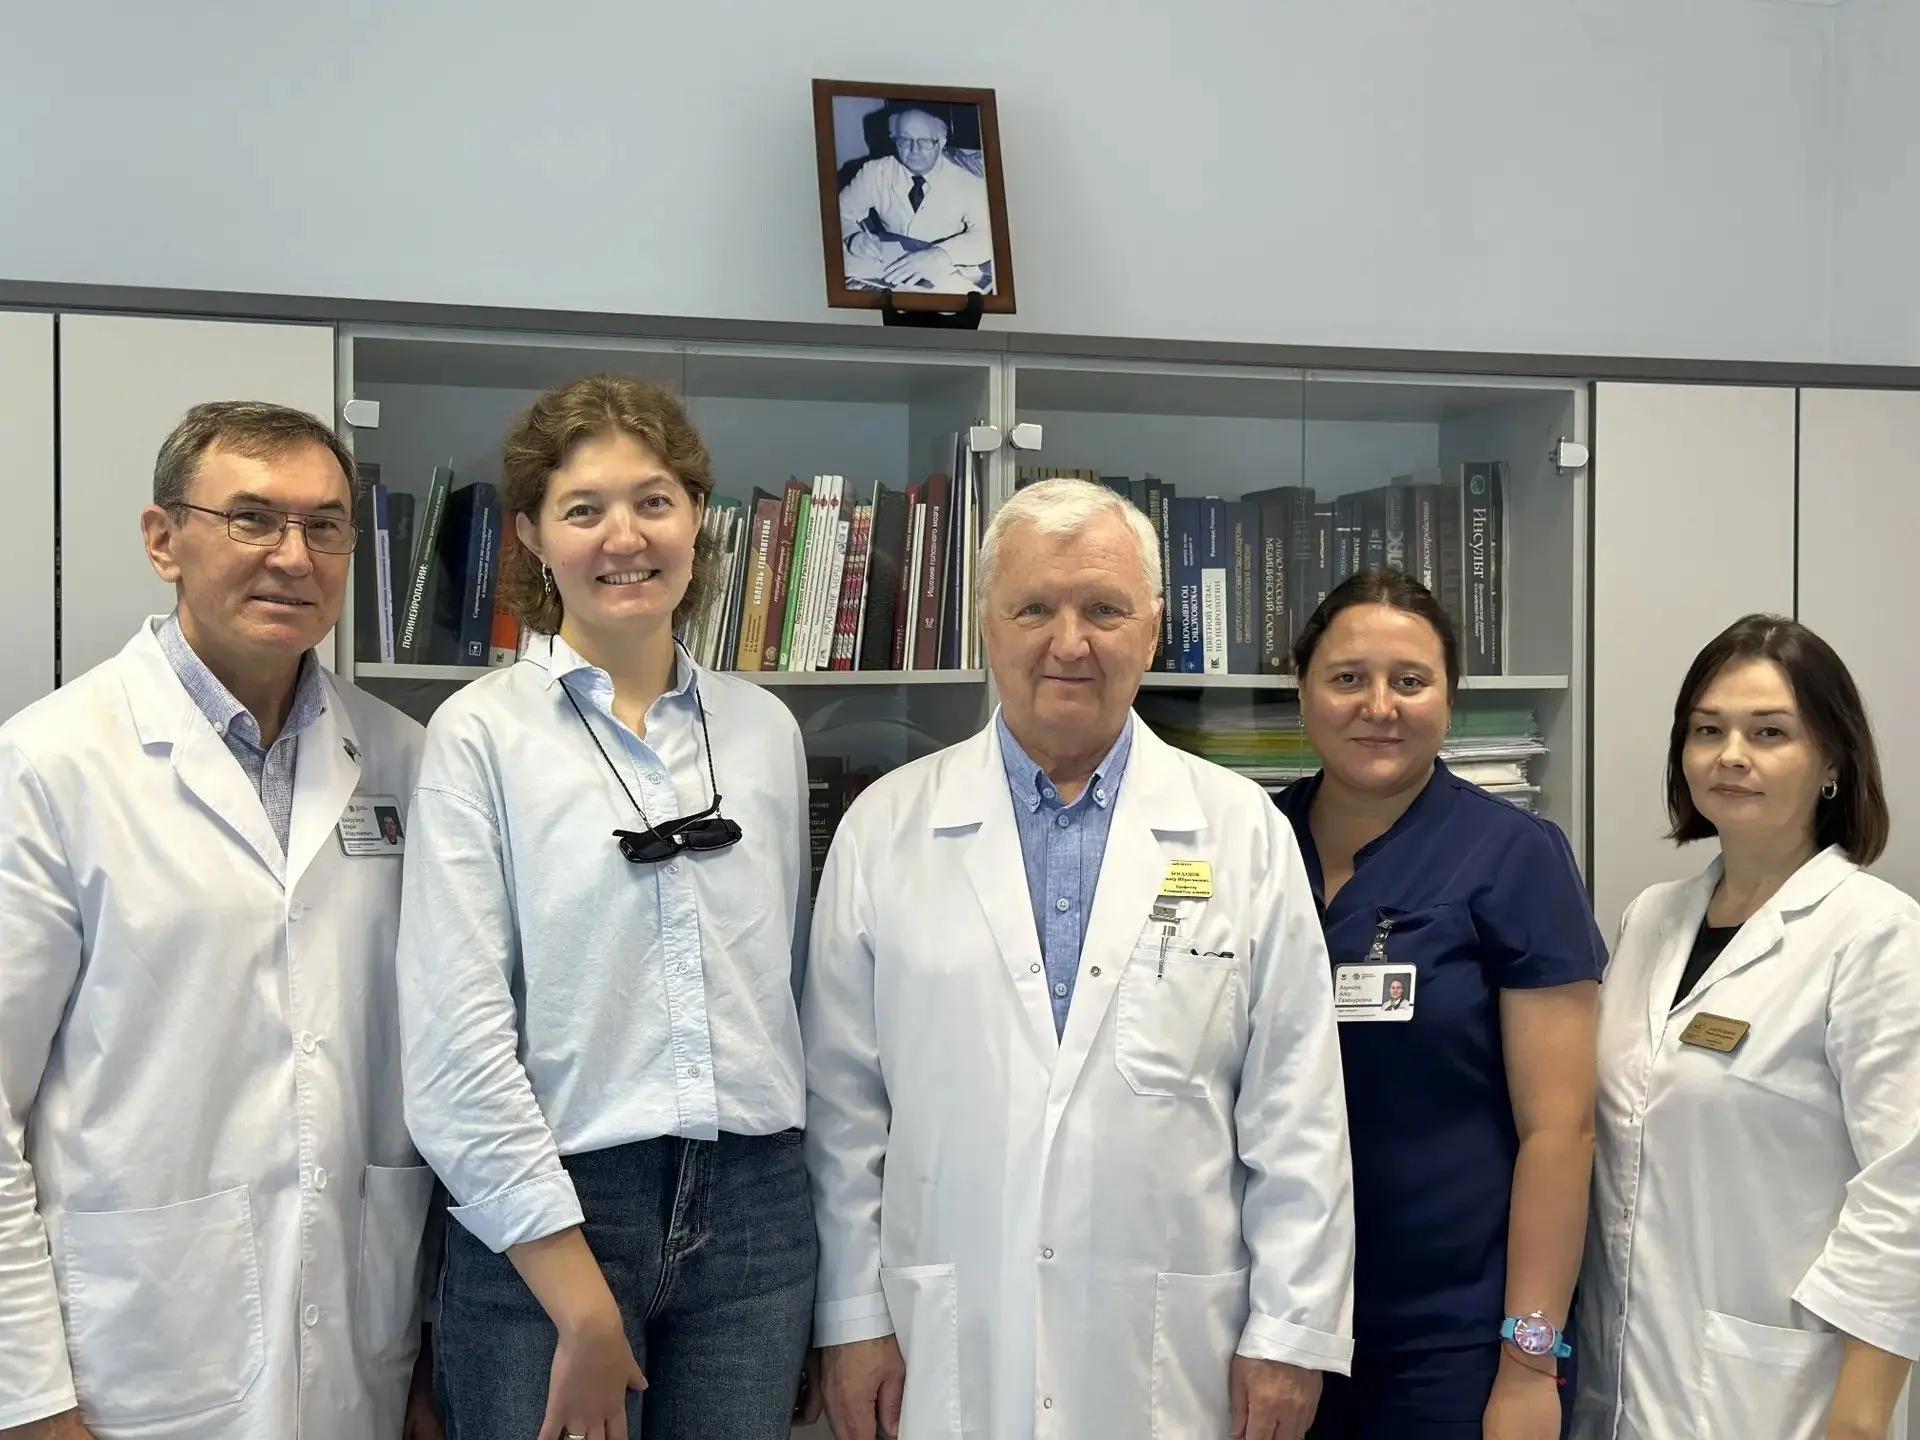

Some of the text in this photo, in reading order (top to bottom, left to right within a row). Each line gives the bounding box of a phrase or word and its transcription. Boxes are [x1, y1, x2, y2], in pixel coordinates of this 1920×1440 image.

[1275, 538, 1284, 616] АНГЛО-РУССКИЙ
[1470, 508, 1486, 579] Инсульт
[1181, 585, 1190, 653] ПО НЕВРОЛОГИИ
[1190, 585, 1199, 643] РУКОВОДСТВО
[1203, 582, 1213, 652] ЦВЕТНОЙ АТЛАС
[1213, 580, 1222, 637] НЕВРОЛОГИИ
[1265, 537, 1275, 654] МЕДИЦИНСКИЙ СЛОВАРЬ
